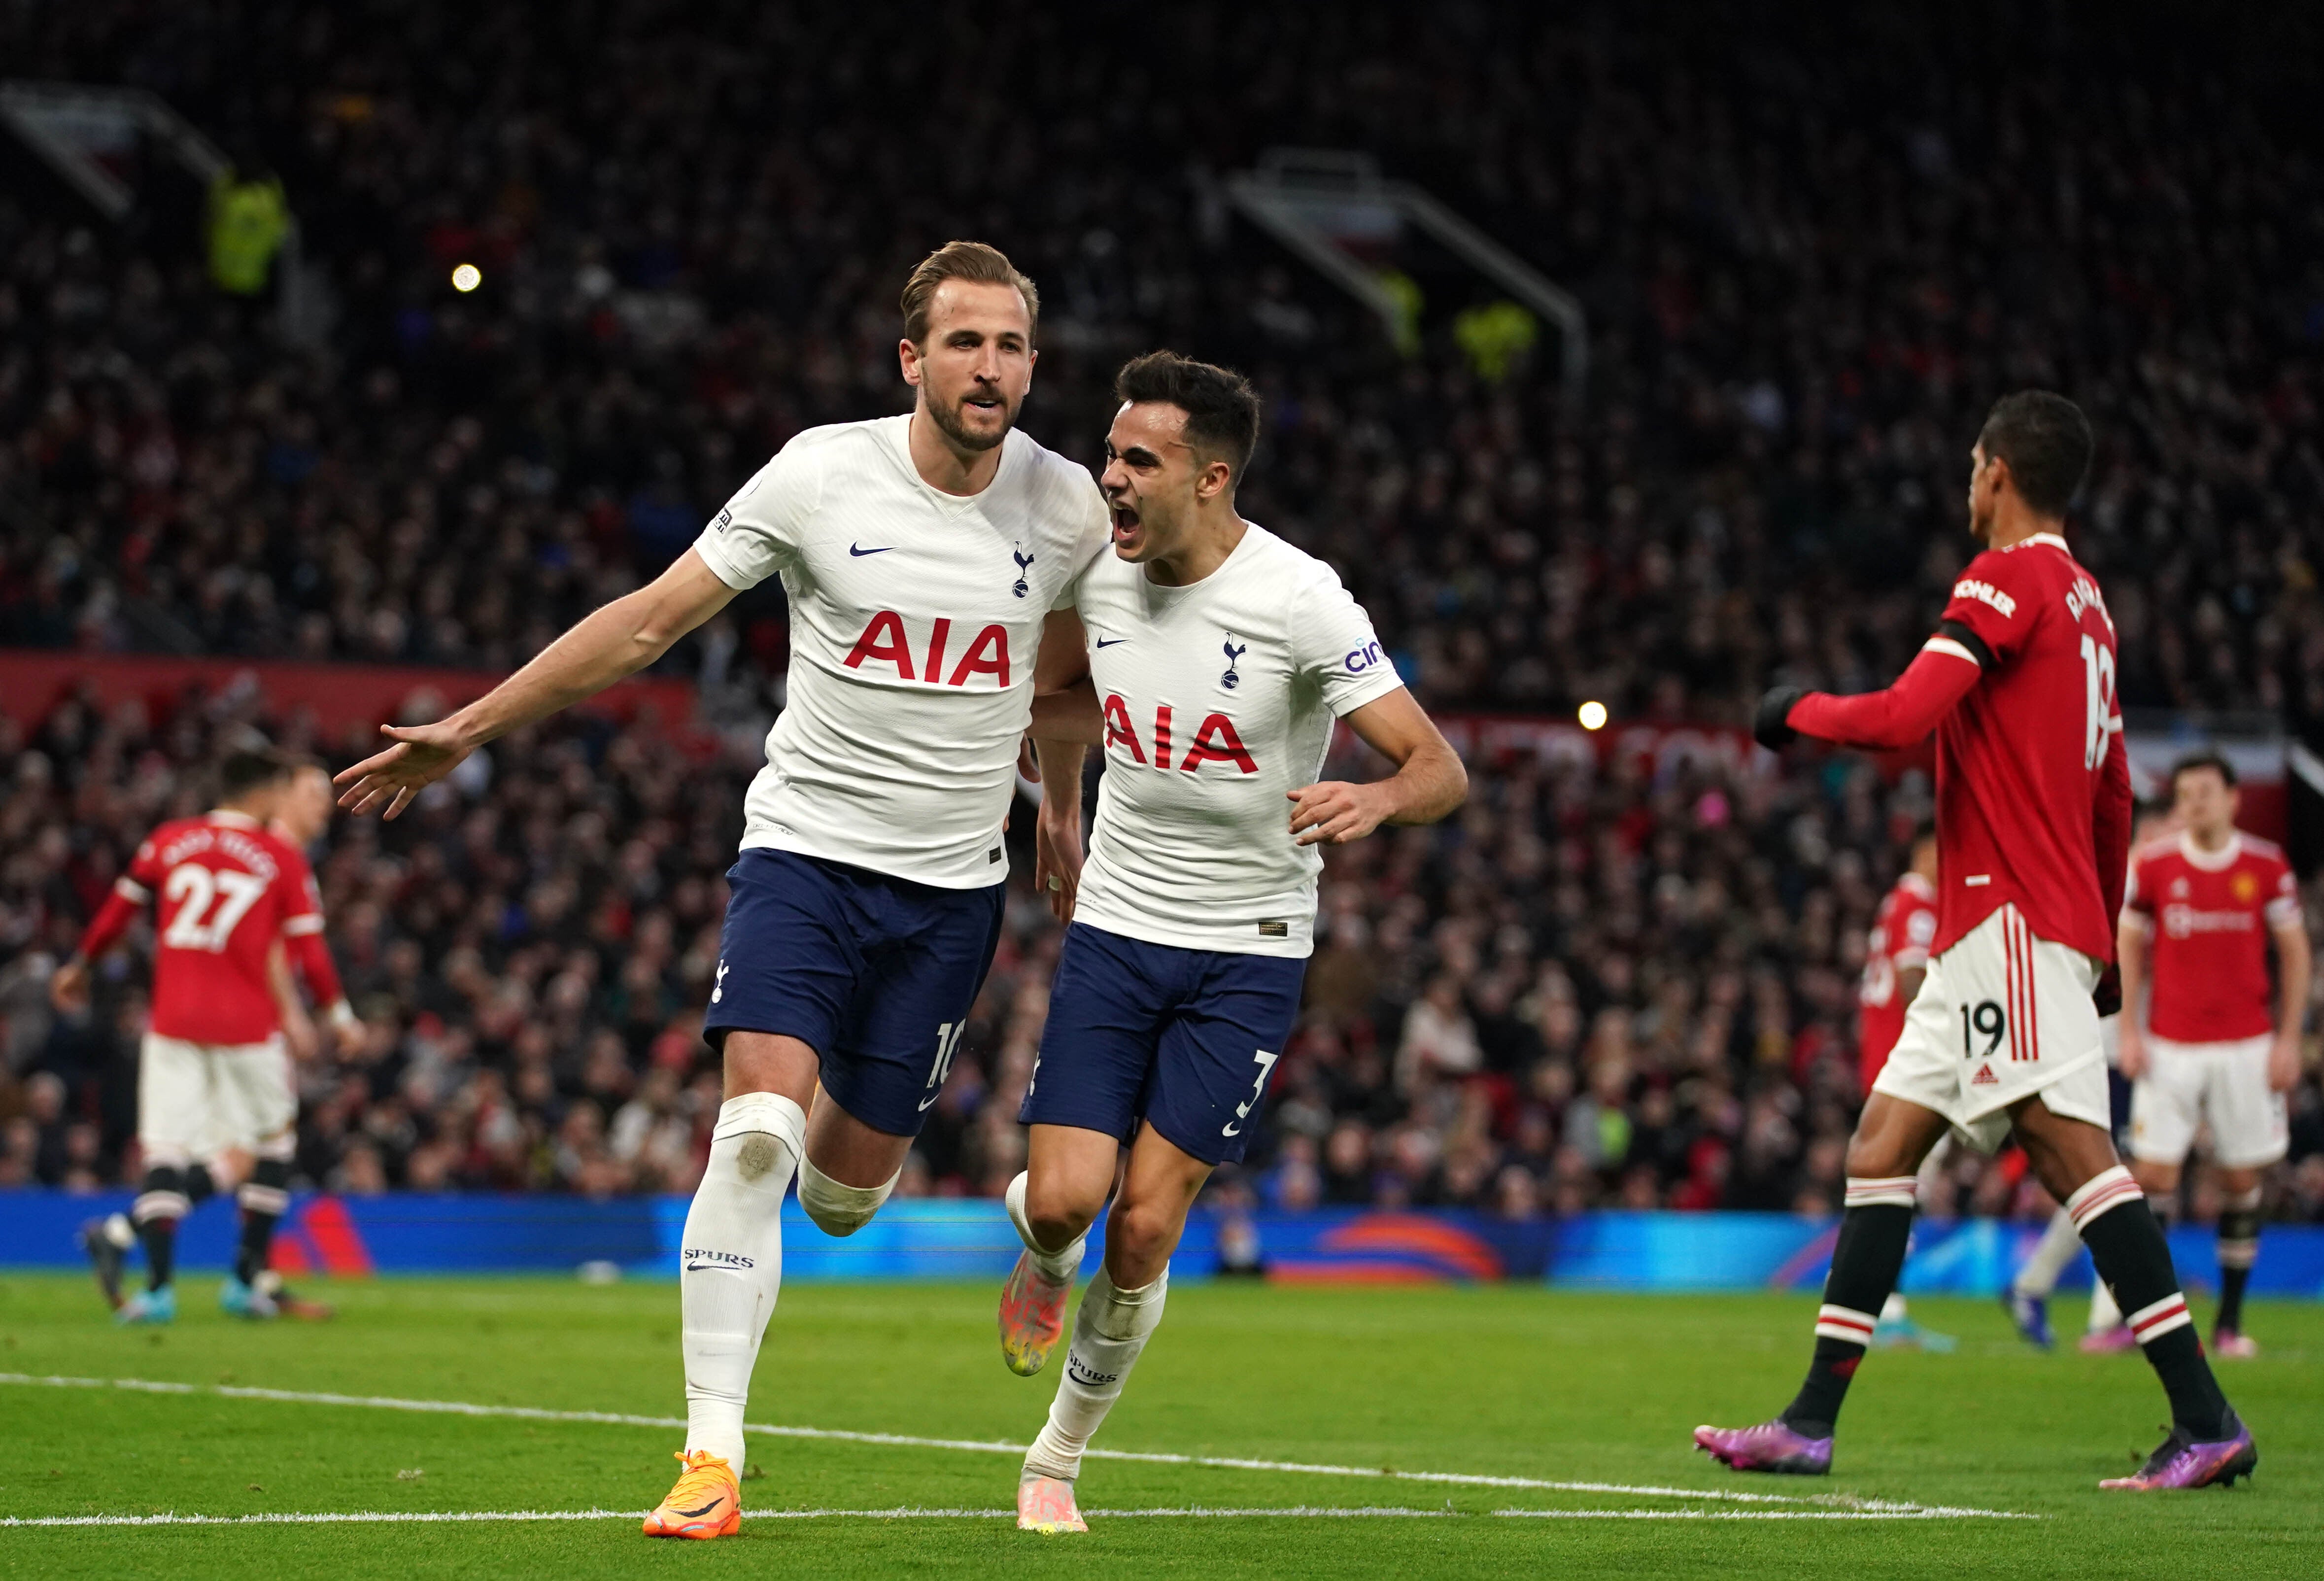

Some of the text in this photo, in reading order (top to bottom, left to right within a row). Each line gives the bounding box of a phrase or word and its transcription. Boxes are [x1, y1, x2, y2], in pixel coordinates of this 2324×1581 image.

[843, 611, 1010, 688] AIA
[1104, 694, 1259, 774] AIA
[2081, 633, 2115, 772] 19
[163, 862, 268, 954] 27
[1960, 1001, 2005, 1059] 19
[1236, 1049, 1279, 1119] 3
[685, 1249, 754, 1268] SPURS
[1069, 1349, 1118, 1382] SPURS
